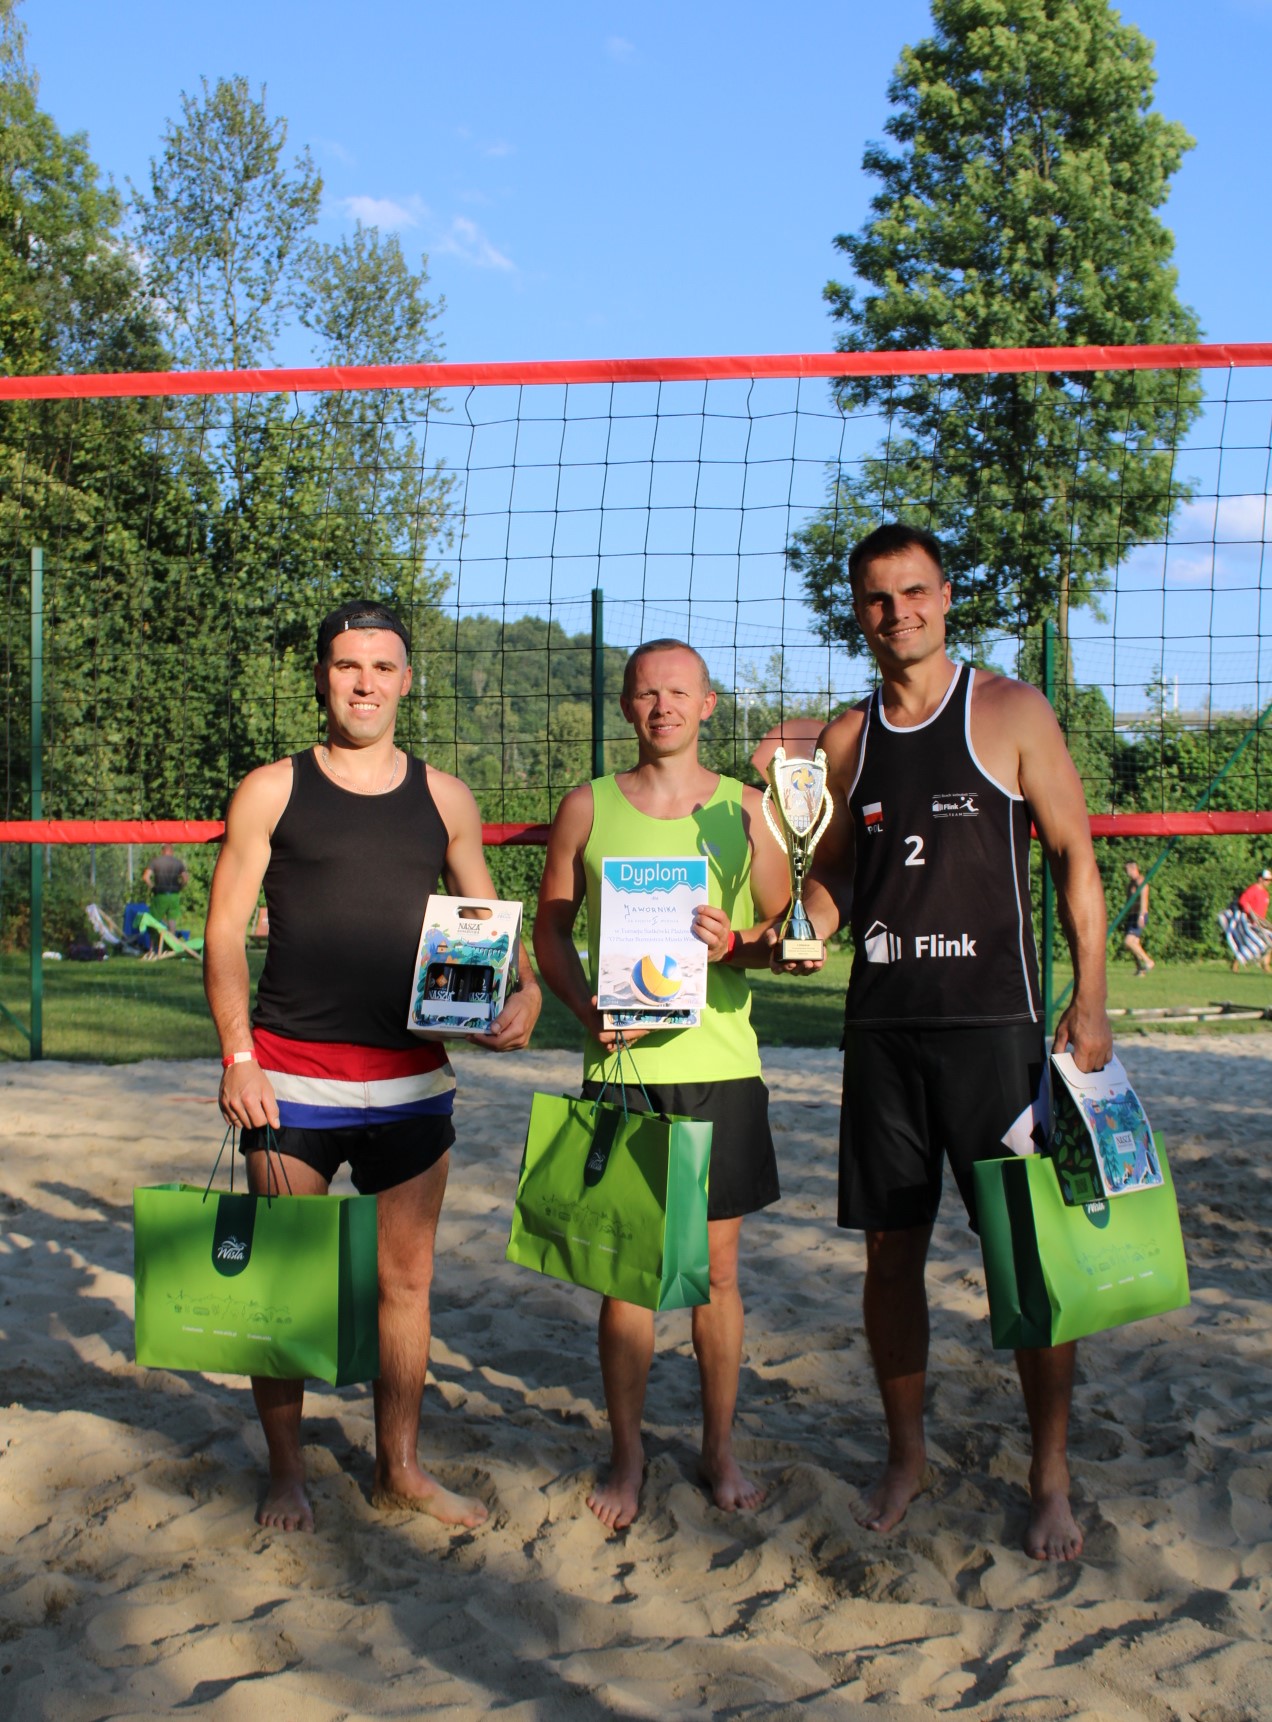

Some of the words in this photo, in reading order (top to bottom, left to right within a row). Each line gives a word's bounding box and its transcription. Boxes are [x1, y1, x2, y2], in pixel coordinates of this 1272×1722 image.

[867, 824, 883, 835] POL
[904, 835, 926, 866] 2
[620, 863, 687, 885] Dyplom
[458, 922, 480, 930] NASZA
[915, 933, 977, 958] Flink
